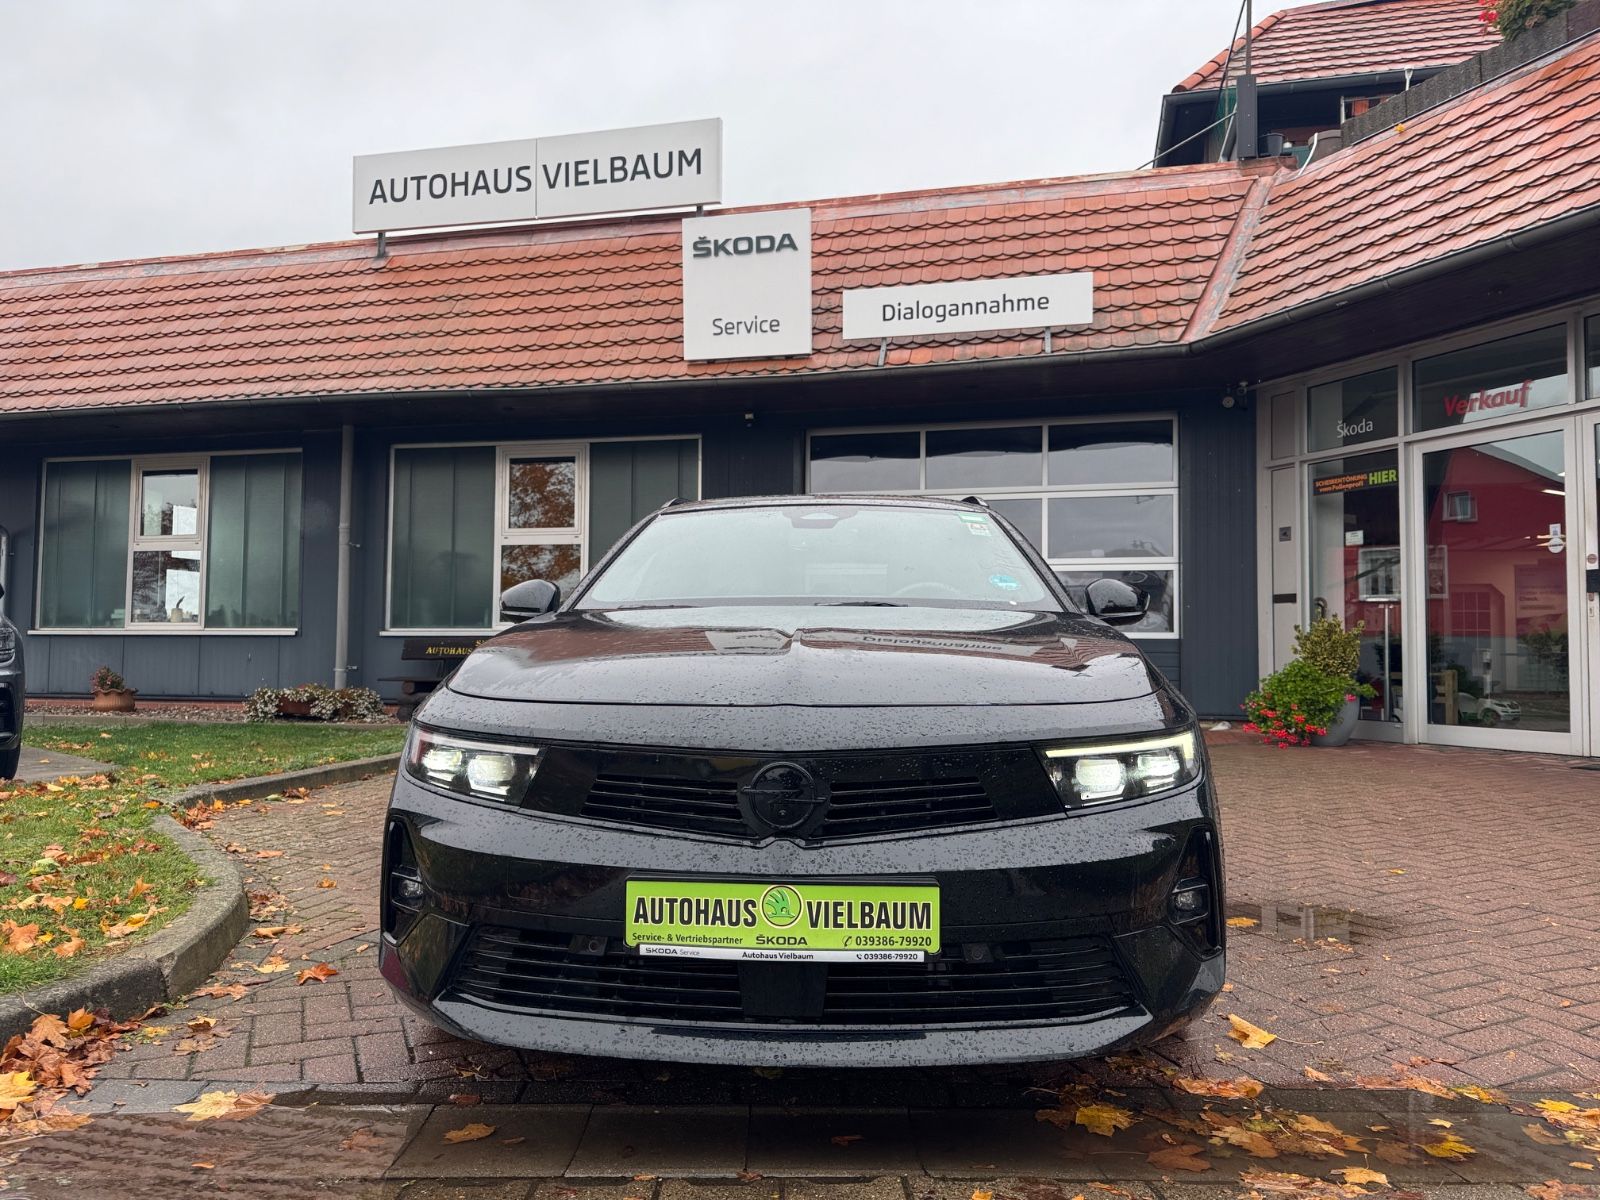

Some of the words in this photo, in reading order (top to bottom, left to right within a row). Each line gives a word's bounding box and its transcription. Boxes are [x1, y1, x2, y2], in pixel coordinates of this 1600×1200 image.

[369, 165, 532, 205] AUTOHAUS
[541, 148, 702, 190] VIELBAUM
[692, 232, 799, 258] ŠKODA
[881, 293, 1051, 324] Dialogannahme
[711, 315, 780, 337] Service
[1443, 379, 1533, 416] Verkauf
[1336, 418, 1374, 439] Škoda
[1368, 469, 1397, 485] HIER
[425, 646, 473, 656] AUTOHAUS
[633, 896, 757, 928] AUTOHAUS
[806, 900, 932, 930] VIELBAUM
[632, 932, 665, 942] Service-
[667, 933, 673, 942] &
[675, 933, 743, 945] Vertriebspartner
[755, 934, 808, 946] ŠKODA
[855, 935, 932, 947] 039386-79920
[742, 951, 778, 959] Autohaus
[778, 952, 814, 960] Vielbaum
